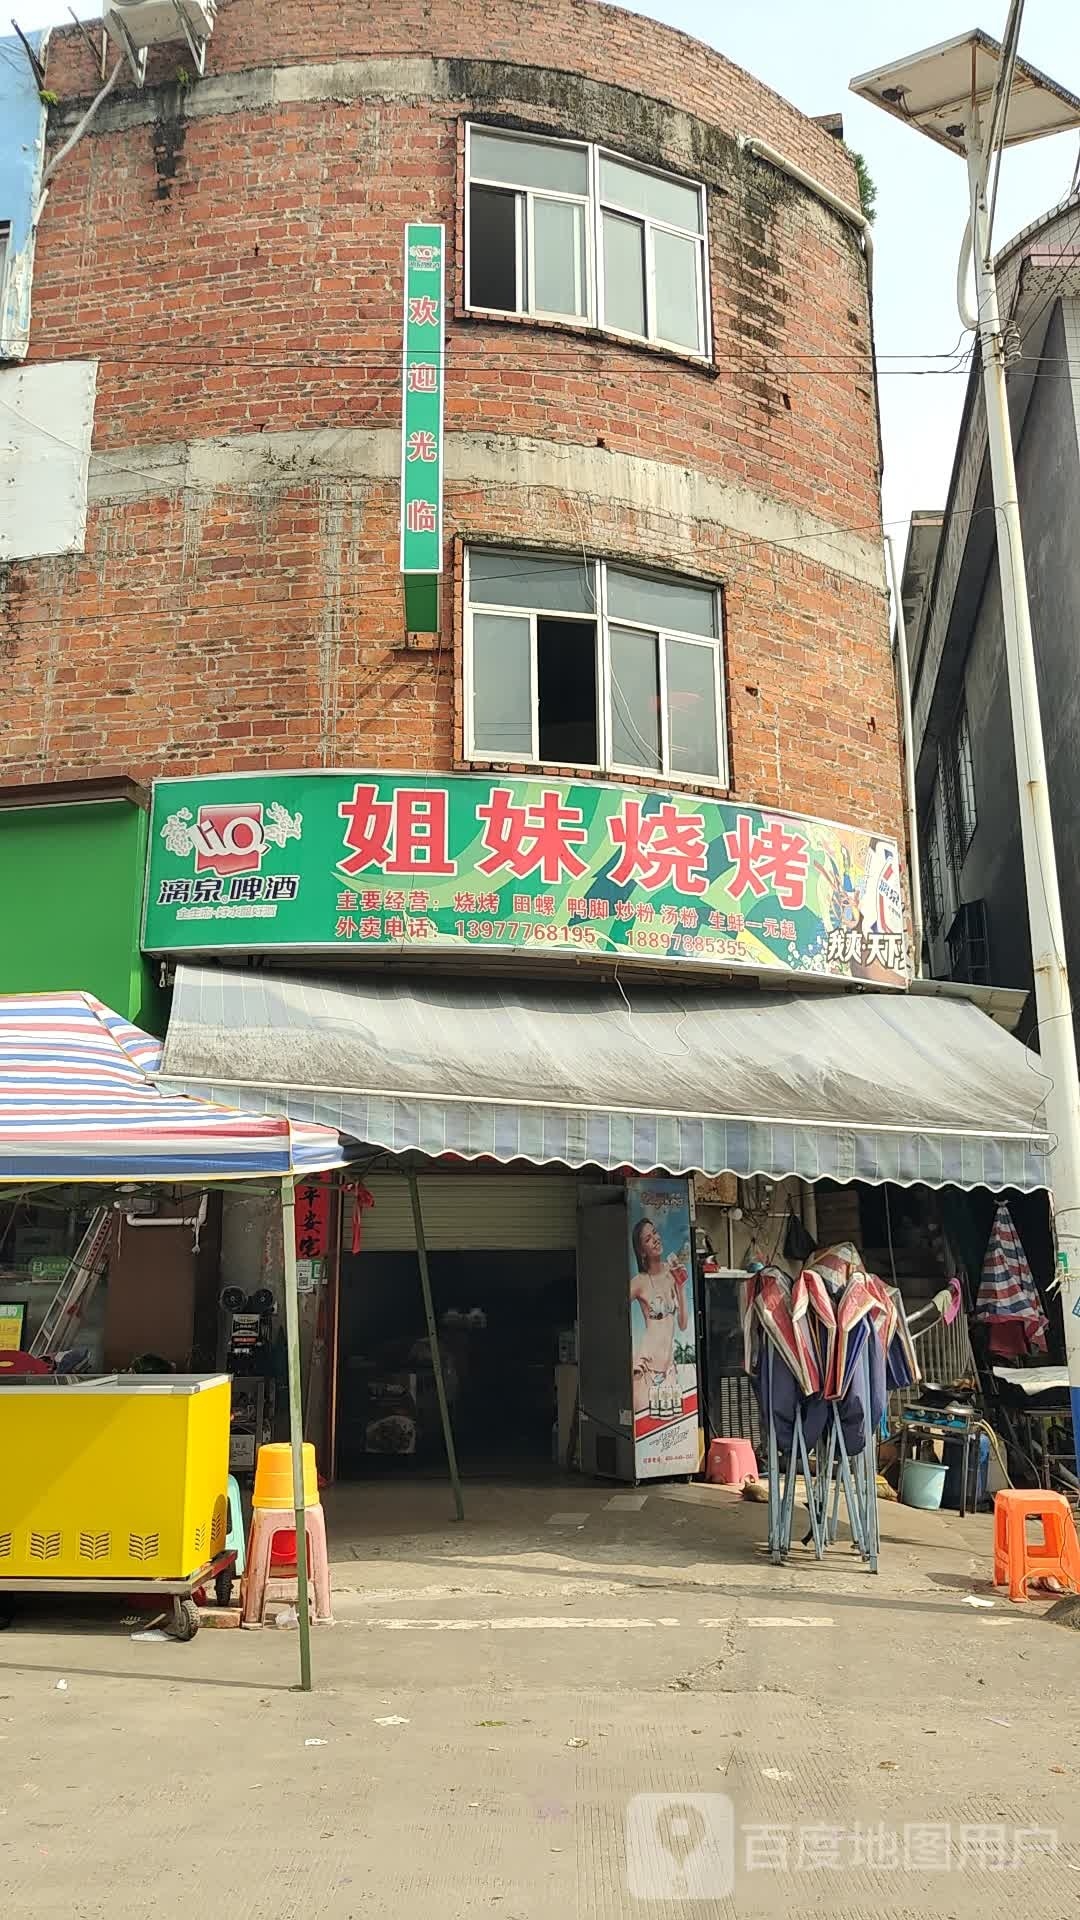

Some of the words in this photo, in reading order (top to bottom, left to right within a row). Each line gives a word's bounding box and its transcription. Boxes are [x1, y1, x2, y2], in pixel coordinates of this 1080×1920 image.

[407, 296, 438, 533] 欢迎光临
[338, 784, 811, 911] 姐妹烧烤
[157, 875, 300, 904] 漓泉啤酒
[453, 891, 499, 914] 烧烤
[513, 894, 556, 917] 田螺
[566, 897, 609, 919] 鸭脚
[614, 900, 655, 923] 炒粉
[661, 904, 698, 929] 汤粉
[708, 911, 798, 941] 生蚝一元起
[455, 920, 596, 944] 13977768195
[626, 930, 747, 957] 18897885355
[298, 1173, 323, 1258] 平安宅
